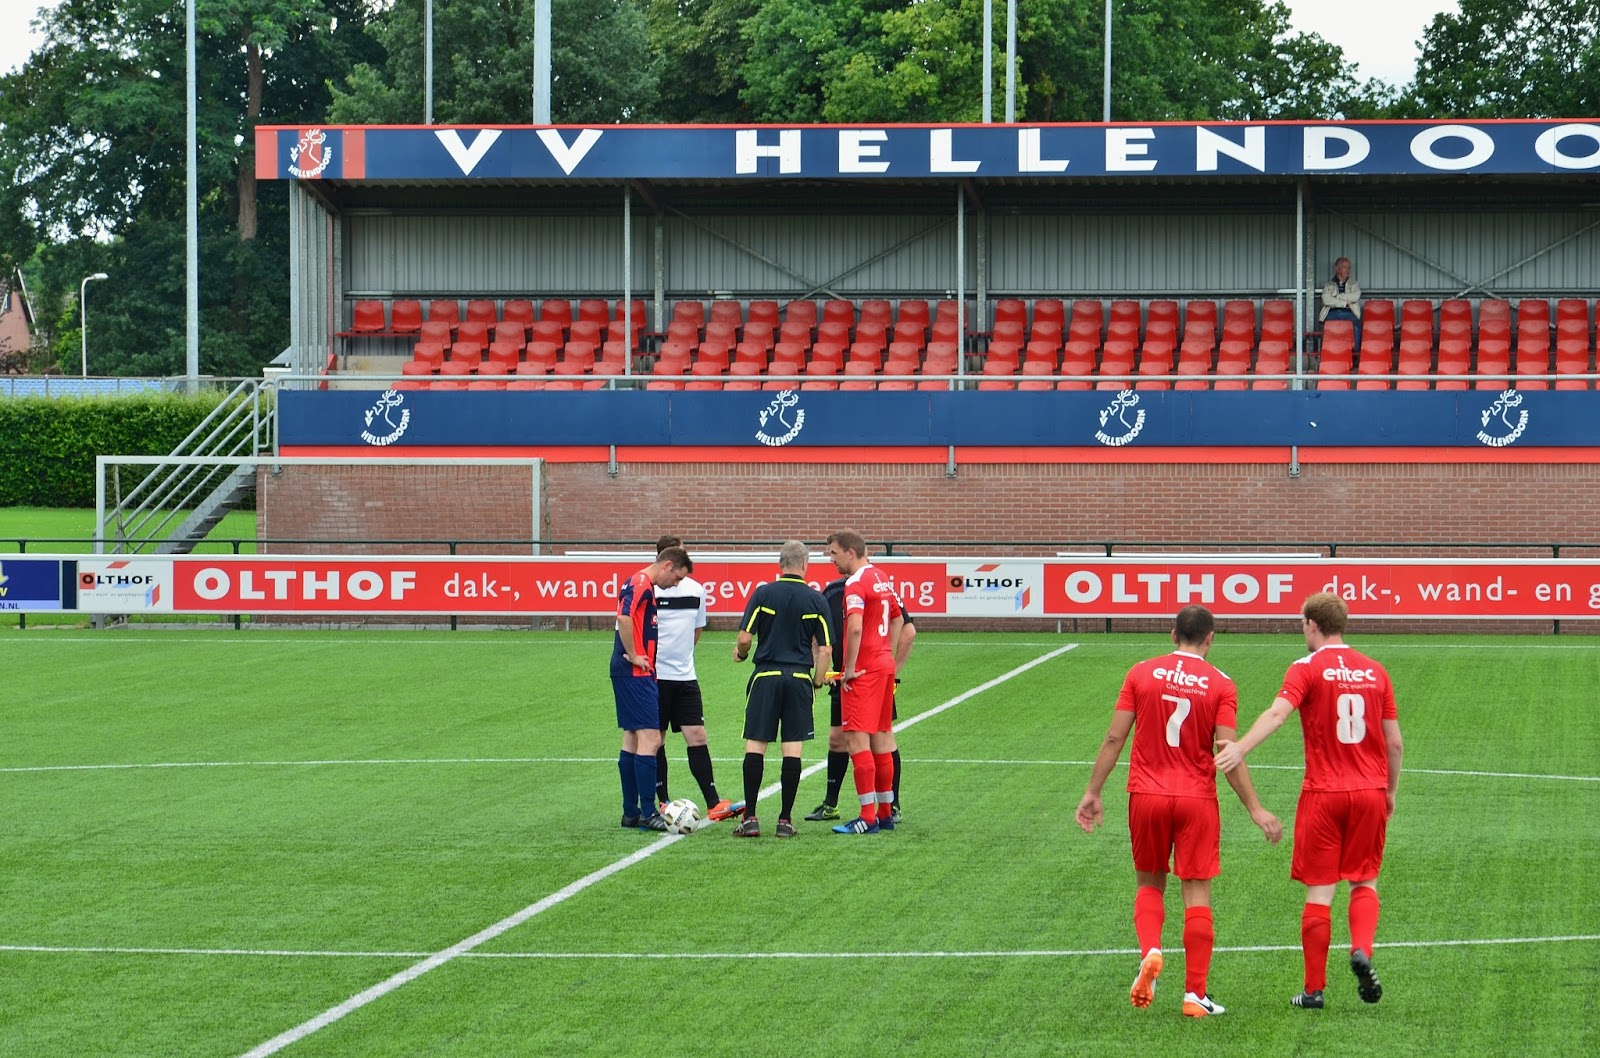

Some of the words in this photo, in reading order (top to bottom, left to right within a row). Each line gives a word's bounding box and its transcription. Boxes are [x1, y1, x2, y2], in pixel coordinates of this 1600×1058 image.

[288, 146, 332, 178] HELLENDOORN
[735, 125, 1600, 174] HELLENDOO
[360, 408, 410, 446] HELLENDOORN
[755, 408, 805, 447] HELLENDOORN
[1095, 409, 1146, 447] HELLENDOORN
[1476, 410, 1528, 447] HELLENDOORN
[82, 574, 154, 585] OLTHOF
[192, 568, 417, 601] OLTHOF
[444, 572, 521, 604] dak-,
[950, 577, 1024, 588] OLTHOF
[1063, 571, 1293, 604] OLTHOF
[1417, 575, 1518, 601] wand-
[1534, 582, 1572, 602] en
[1152, 660, 1209, 689] eritec
[1322, 655, 1377, 682] eritec
[1161, 693, 1191, 748] 7
[1336, 693, 1367, 744] 8
